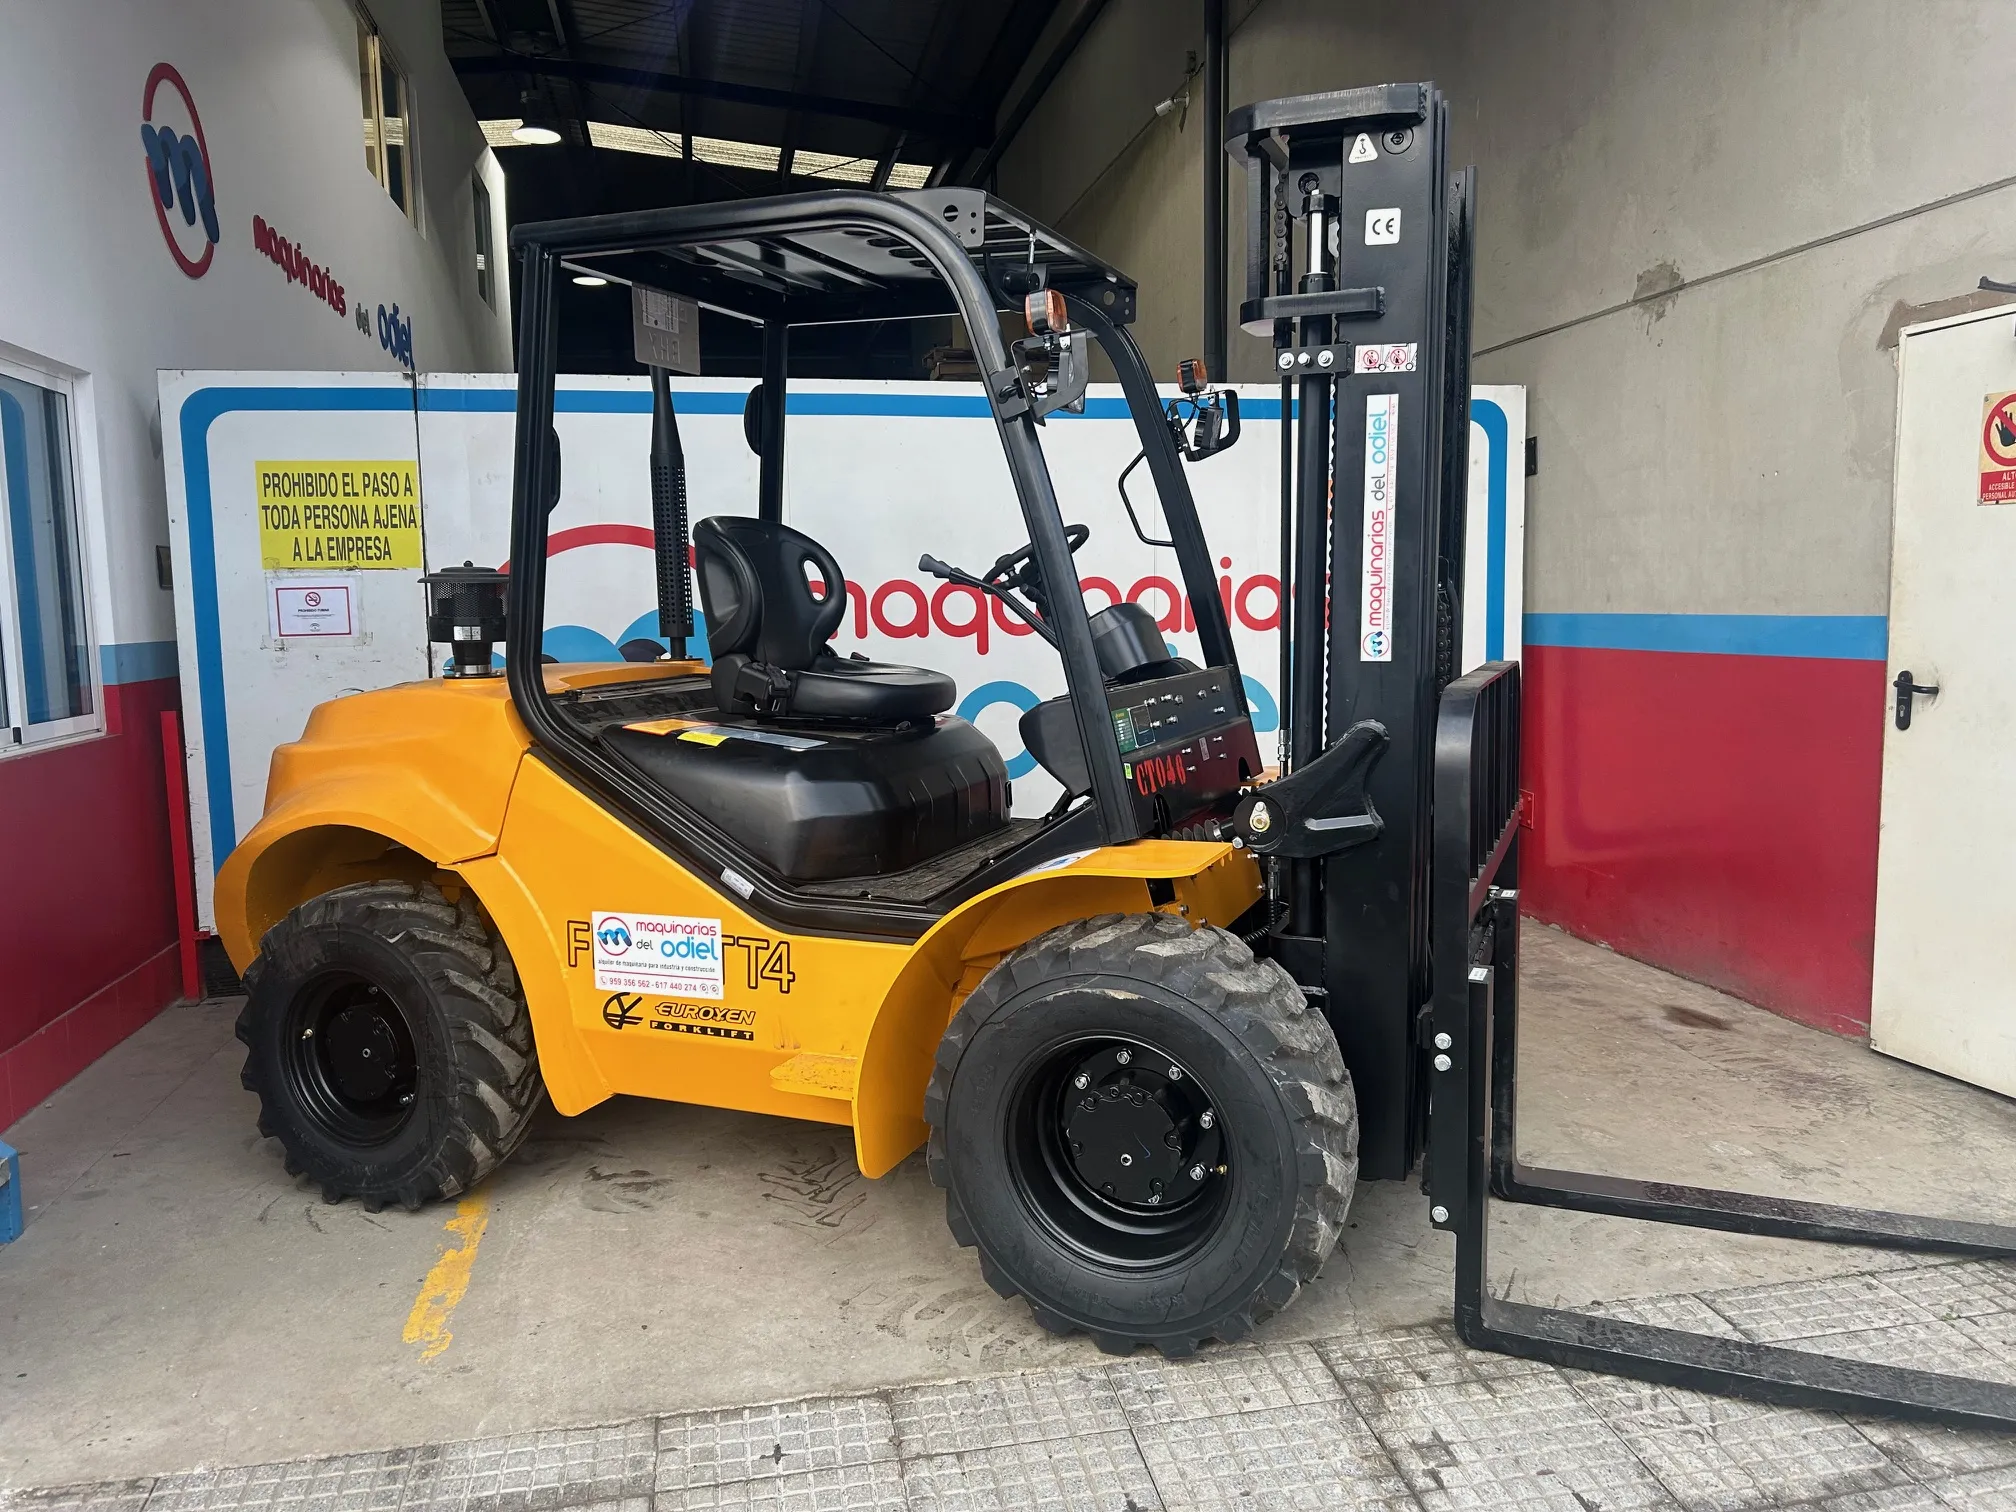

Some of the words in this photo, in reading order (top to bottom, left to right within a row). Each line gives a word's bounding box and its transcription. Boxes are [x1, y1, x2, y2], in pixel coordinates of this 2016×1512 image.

[355, 302, 371, 339] del
[1368, 409, 1388, 464] odiel
[262, 471, 338, 498] PROHIBIDO
[341, 472, 360, 497] EL
[362, 472, 399, 497] PASO
[403, 472, 413, 497] A
[1371, 473, 1385, 501] del
[1982, 491, 2008, 500] PERSONAL
[1988, 481, 2015, 491] ACCESIBLE
[261, 504, 301, 530] TODA
[303, 504, 370, 530] PERSONA
[373, 504, 417, 529] AJENA
[292, 536, 303, 562] A
[305, 536, 324, 562] LA
[326, 536, 392, 561] EMPRESA
[1366, 509, 1387, 627] maquinarias
[635, 920, 717, 936] maquinarias
[636, 938, 653, 950] del
[660, 936, 719, 961] odiel
[609, 977, 622, 985] 959
[623, 978, 635, 986] 356
[637, 979, 650, 988] 562
[655, 981, 667, 989] 617
[669, 982, 682, 990] 440
[684, 983, 697, 991] 274
[651, 1021, 752, 1040] FORKLIFT
